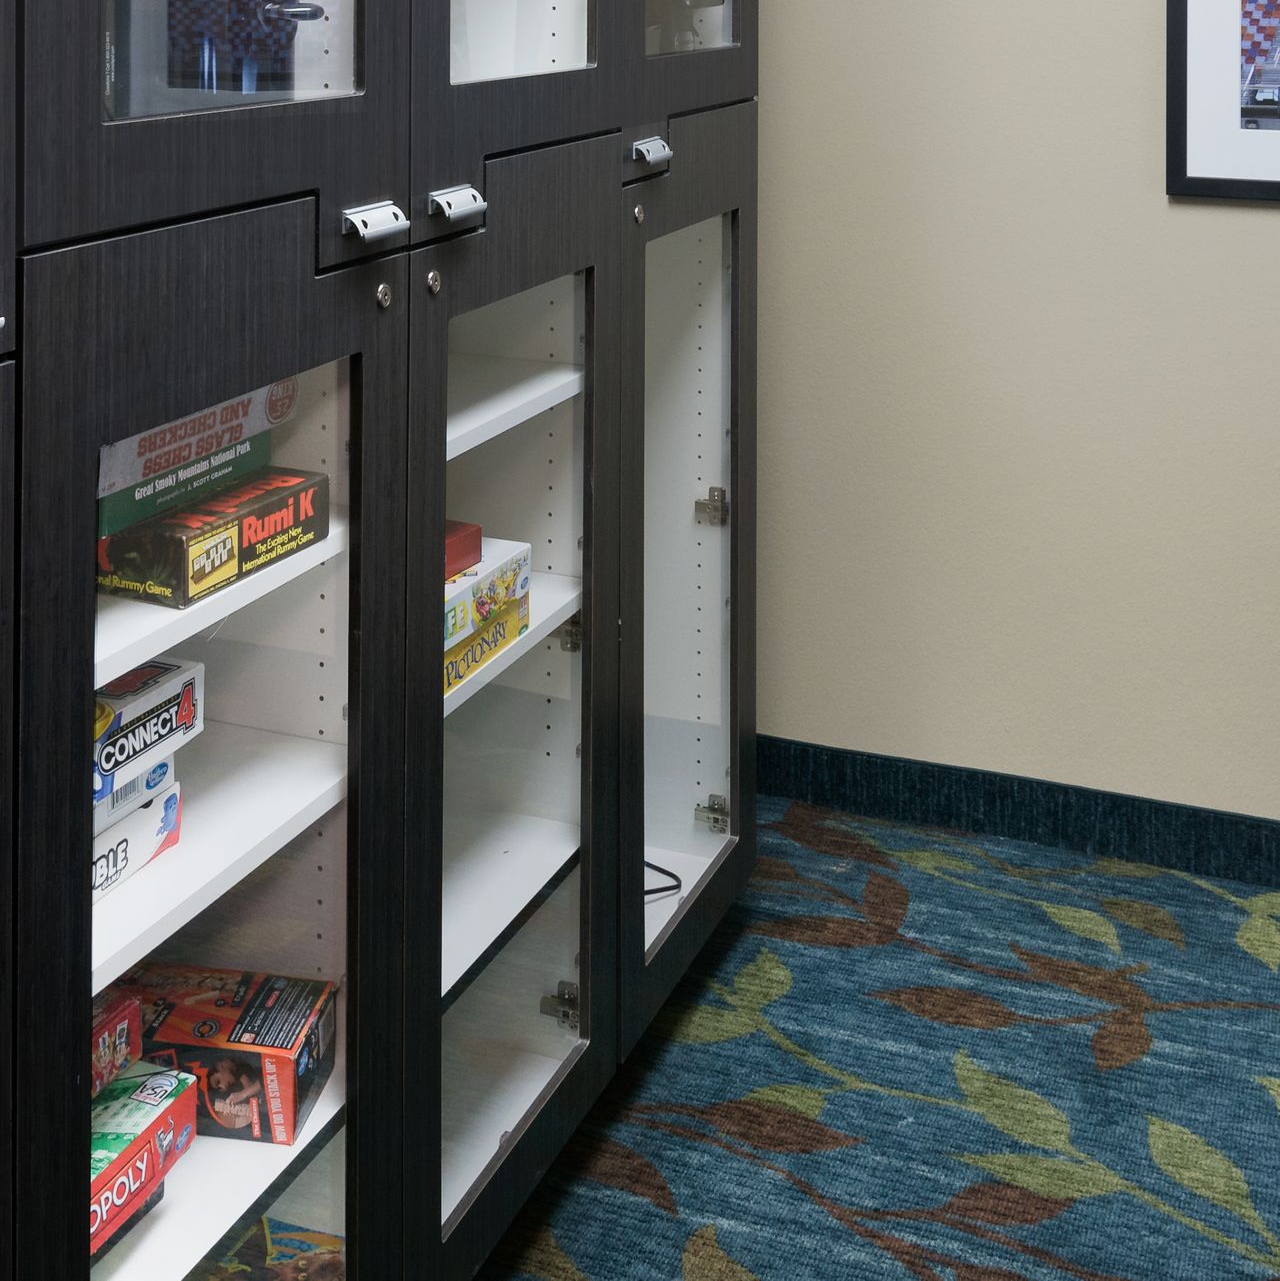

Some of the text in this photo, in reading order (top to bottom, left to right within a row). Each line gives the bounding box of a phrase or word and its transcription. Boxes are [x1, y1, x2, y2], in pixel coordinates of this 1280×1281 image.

[137, 398, 251, 457] AND CHECKERS
[142, 424, 243, 479] GLASS CHESS
[135, 482, 153, 500] Great
[154, 474, 177, 494] Smoky
[178, 459, 209, 481] Mountains
[210, 449, 235, 467] National
[236, 441, 251, 457] Park
[193, 476, 210, 488] SCOTT
[210, 466, 232, 480] GRAHAM
[242, 497, 294, 548] Rumi
[300, 489, 314, 522] K
[255, 526, 302, 555] The Exciting New
[242, 531, 314, 572] International Rummy Game
[113, 577, 144, 593] Rummy
[145, 581, 173, 598] Game
[445, 620, 508, 688] PICTIONARY
[100, 682, 194, 770] CONNECT 4
[140, 1083, 167, 1098] USA
[265, 1058, 287, 1142] HOW DO YOU STACK UP?
